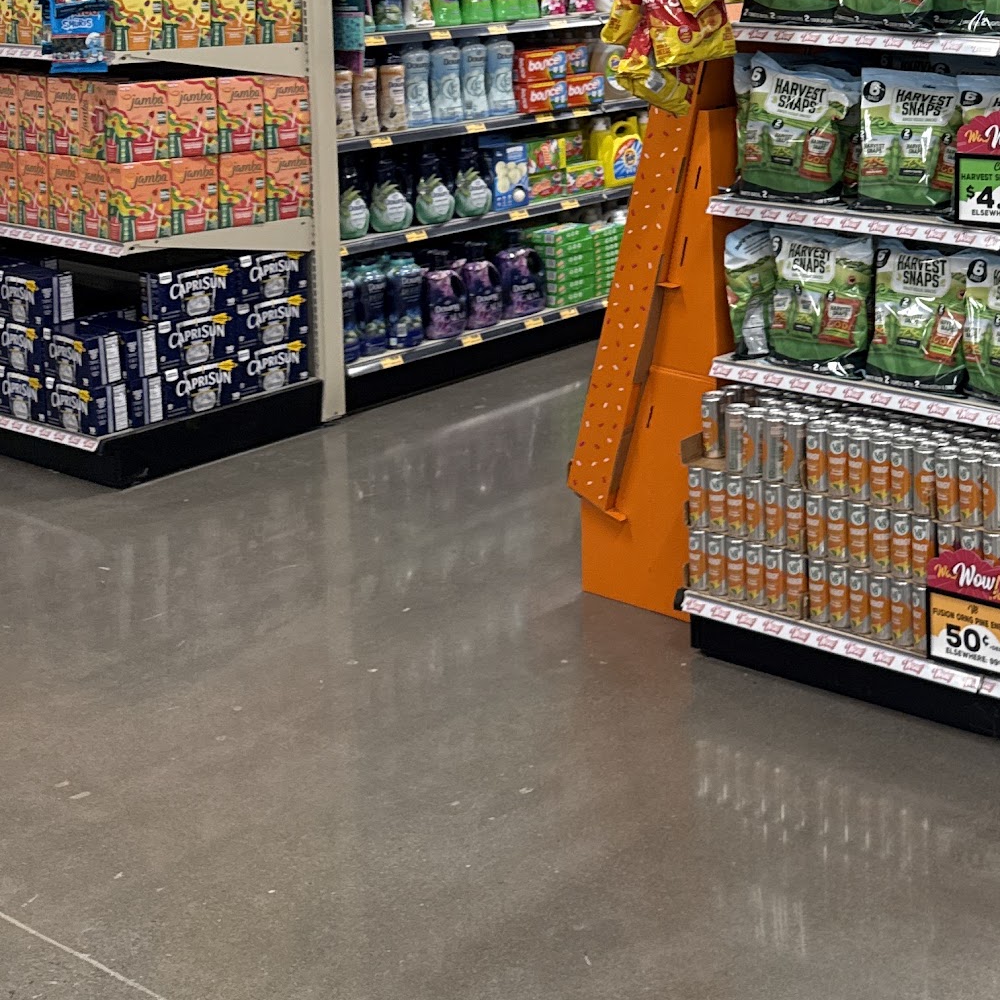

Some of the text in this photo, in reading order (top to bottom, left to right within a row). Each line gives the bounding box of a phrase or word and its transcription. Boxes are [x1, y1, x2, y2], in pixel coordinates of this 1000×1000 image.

[528, 54, 562, 72] bounce
[751, 66, 763, 82] 6
[229, 86, 260, 103] jamba
[273, 83, 305, 99] jamba
[530, 85, 563, 102] bounce
[568, 82, 600, 96] bounce
[775, 78, 827, 101] HARVEST
[128, 93, 164, 111] jamba
[177, 90, 213, 107] jamba
[777, 95, 818, 114] SNAPS
[896, 89, 955, 107] HARVEST
[901, 102, 943, 117] SNAPS
[231, 160, 261, 177] jamba
[276, 156, 308, 173] jamba
[132, 172, 168, 189] jamba
[181, 166, 215, 183] jamba
[897, 254, 947, 276] HARVEST
[903, 268, 940, 287] SNAPS
[953, 563, 1000, 593] Wow!
